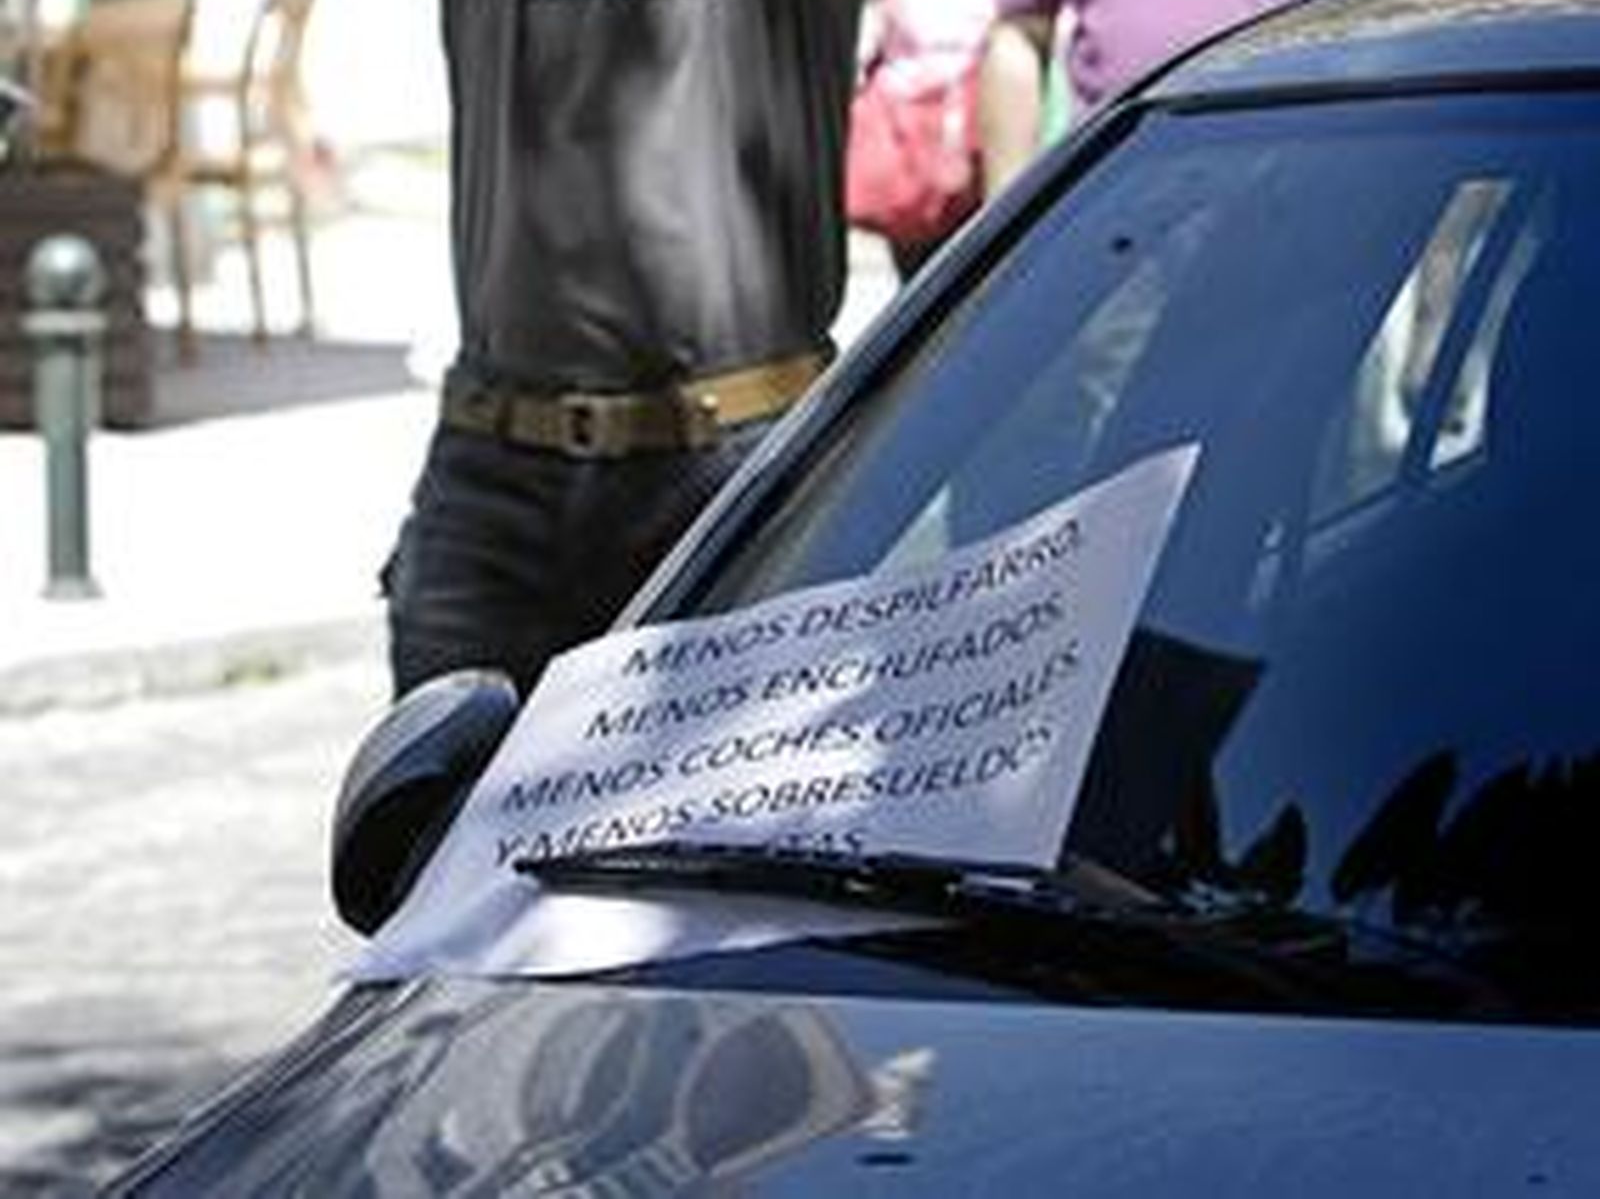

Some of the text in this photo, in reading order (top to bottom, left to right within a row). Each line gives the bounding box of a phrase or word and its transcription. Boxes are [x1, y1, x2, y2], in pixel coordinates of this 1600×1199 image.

[621, 613, 792, 678] MENOS
[502, 638, 1082, 813] MENOS COCHES OFICIALES
[584, 676, 750, 742] MENOS
